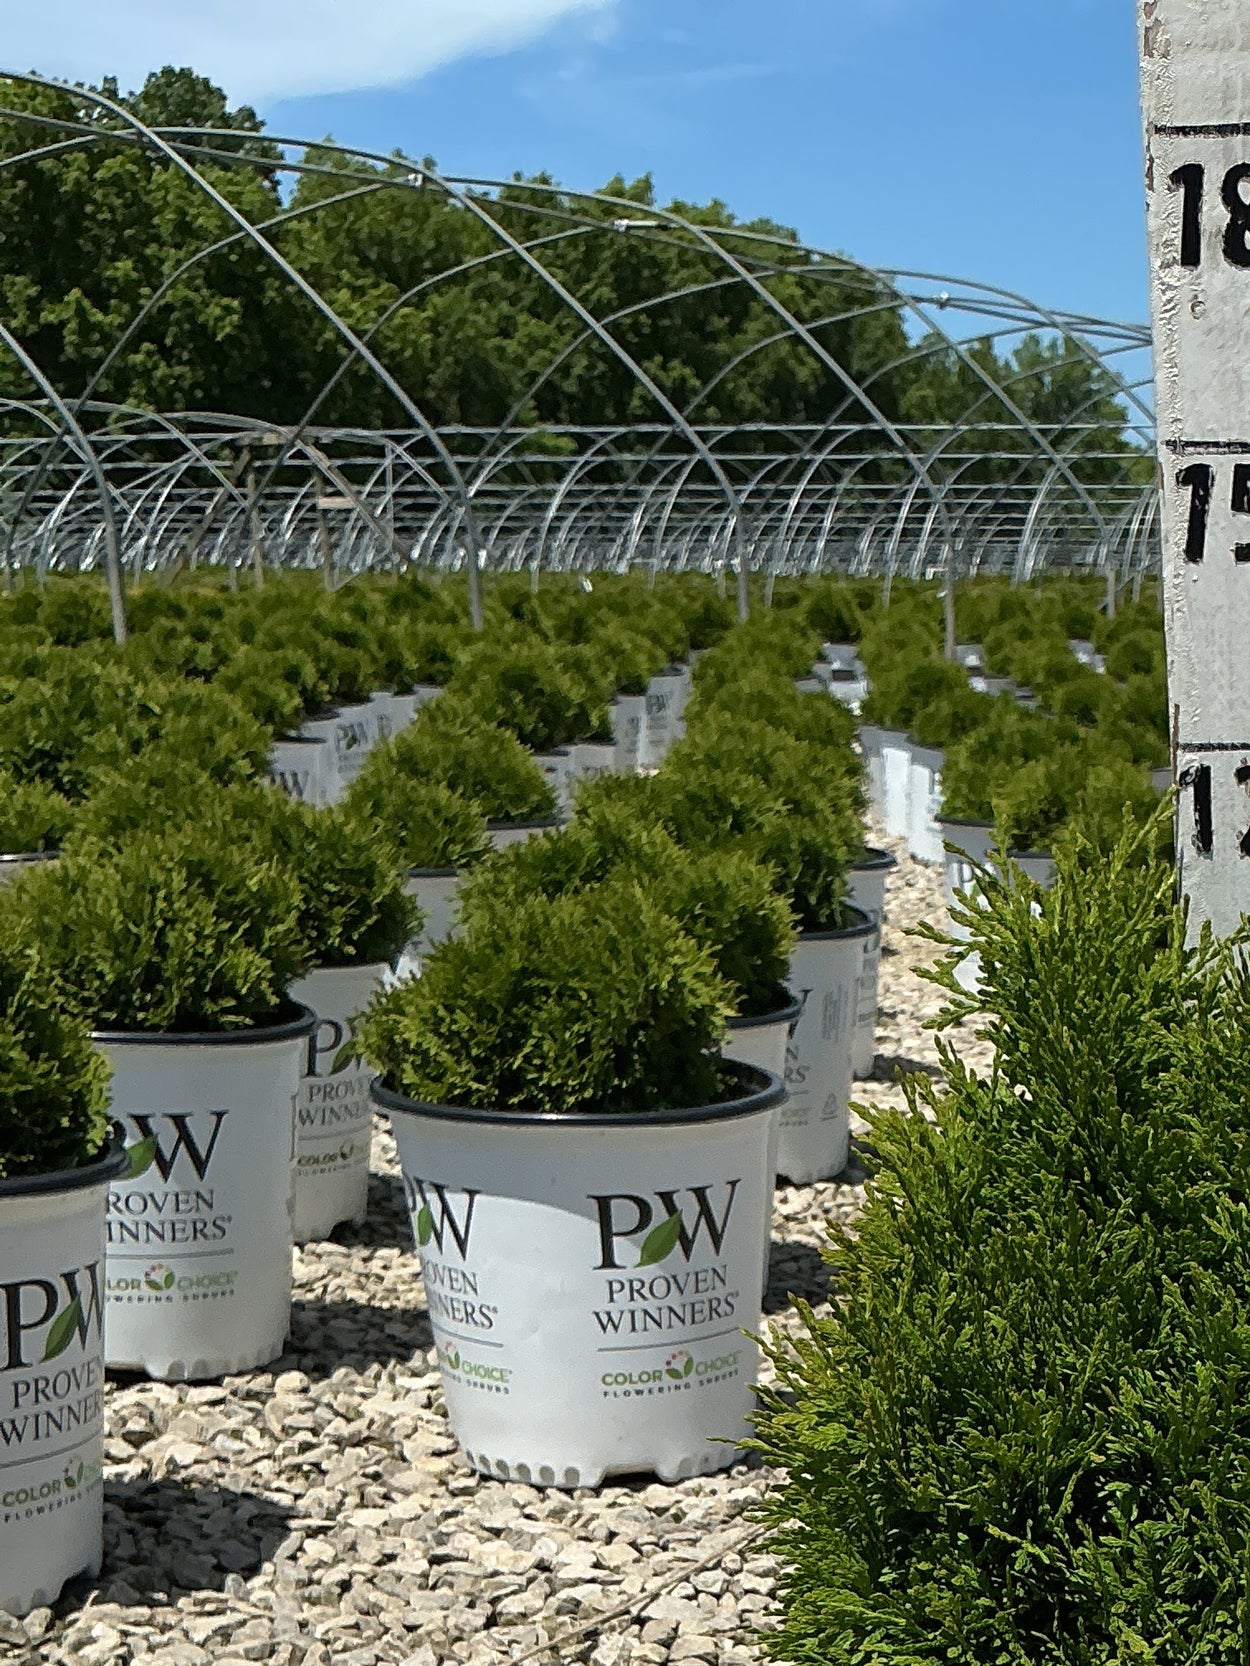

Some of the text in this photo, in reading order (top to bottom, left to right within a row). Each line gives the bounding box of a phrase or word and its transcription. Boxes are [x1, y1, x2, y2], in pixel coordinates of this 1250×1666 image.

[107, 1188, 215, 1216] ROVEN
[106, 1215, 232, 1244] INNERS
[587, 1178, 742, 1271] PW
[606, 1264, 727, 1304] PROVEN
[12, 1354, 101, 1410] PROVE
[601, 1370, 664, 1387] COLOR
[603, 1382, 692, 1398] FLOWERING
[3, 1478, 62, 1508] COLOR
